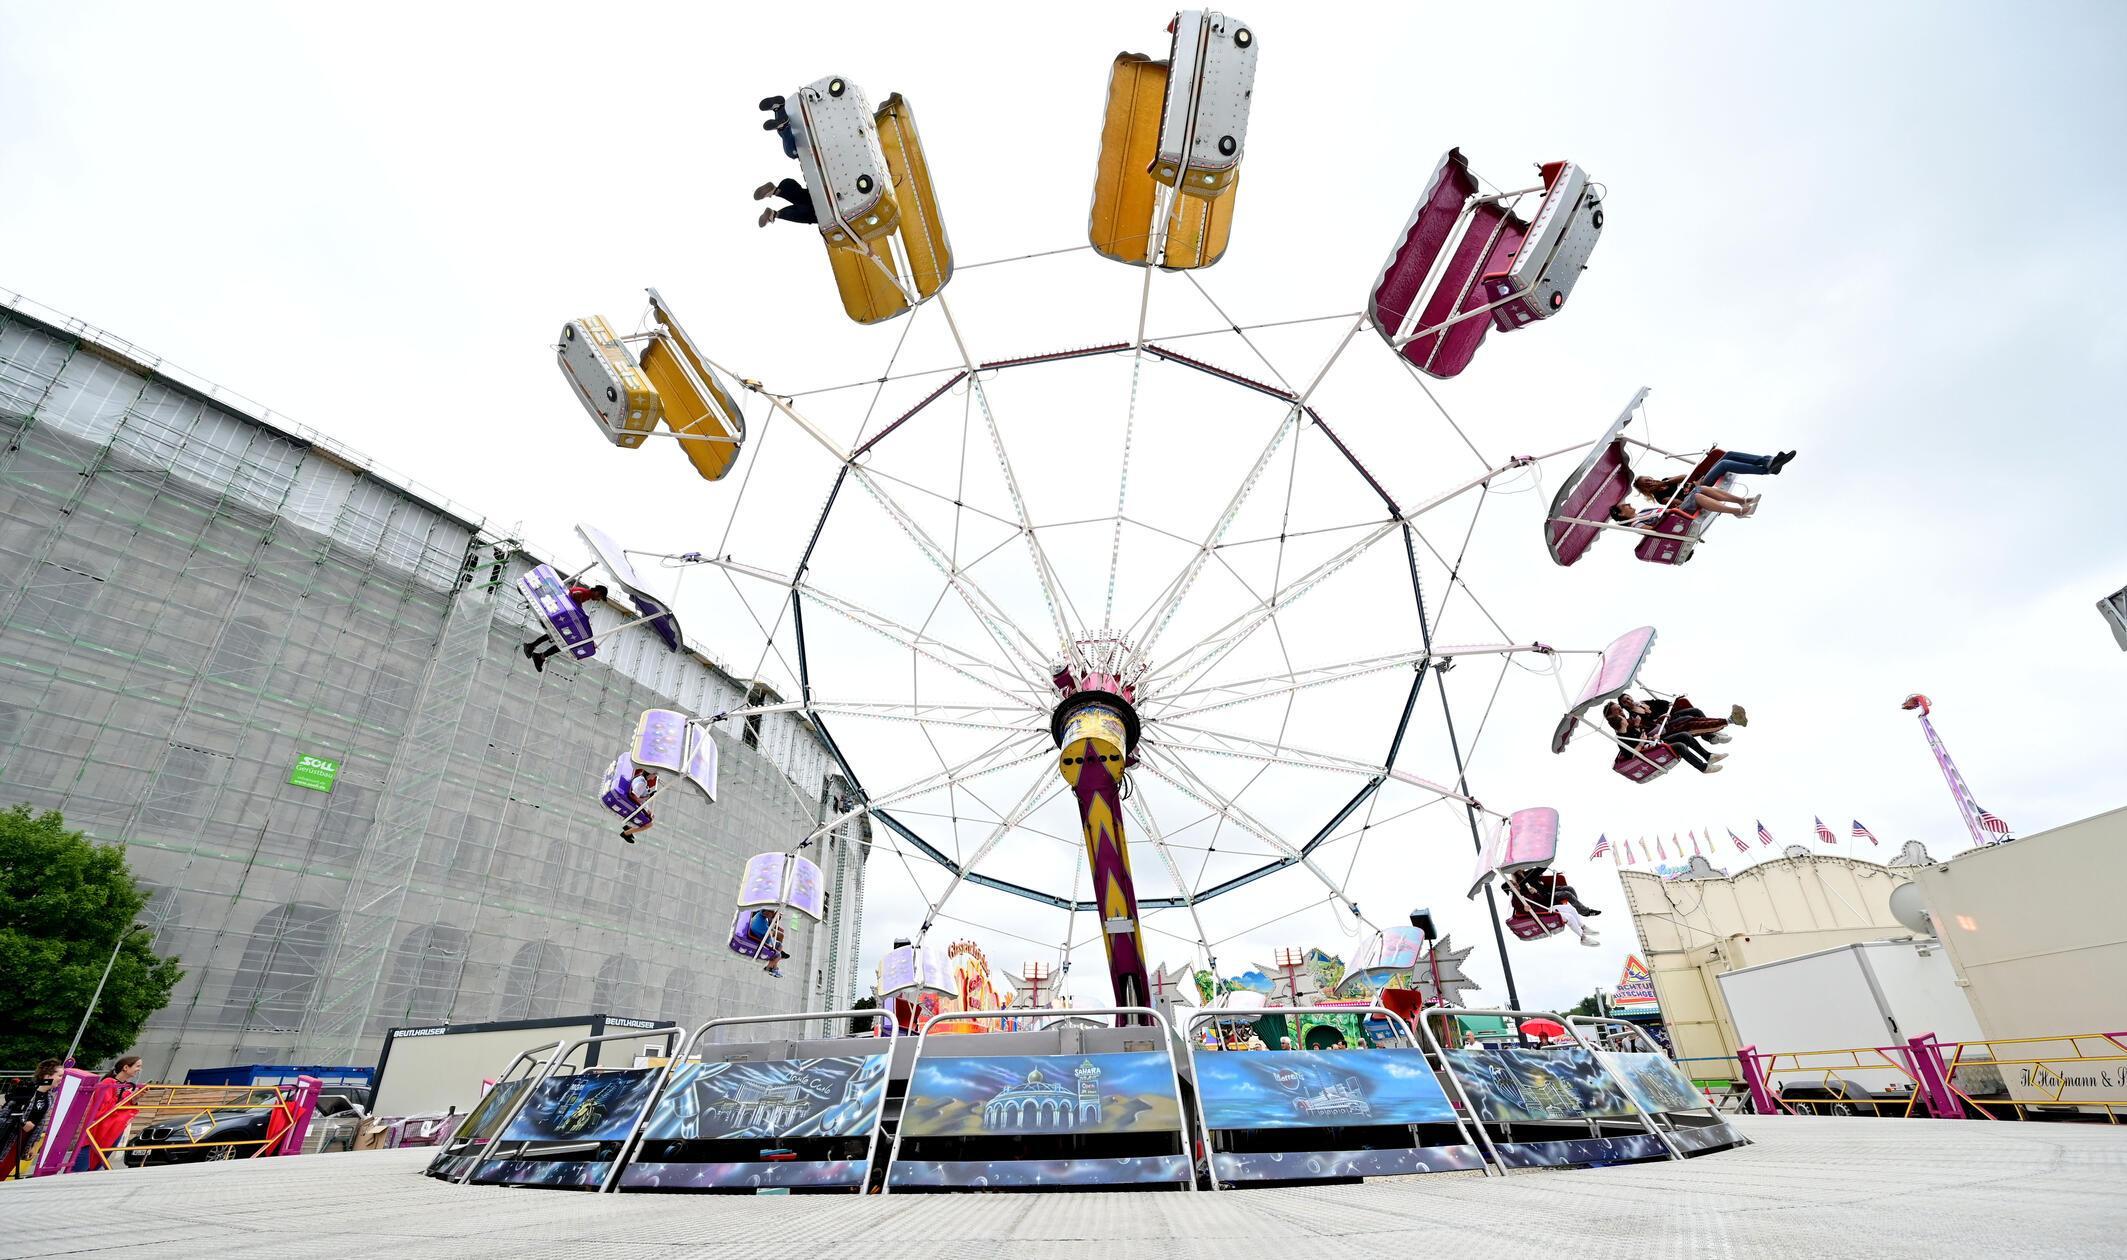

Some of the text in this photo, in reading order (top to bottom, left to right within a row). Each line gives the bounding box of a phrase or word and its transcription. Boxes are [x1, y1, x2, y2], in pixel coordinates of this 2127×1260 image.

[605, 1017, 654, 1029] BEUTLHAUSER
[393, 1028, 446, 1038] BEUTLHAUSER
[1074, 1067, 1101, 1078] SAHARA
[2101, 1070, 2113, 1087] &
